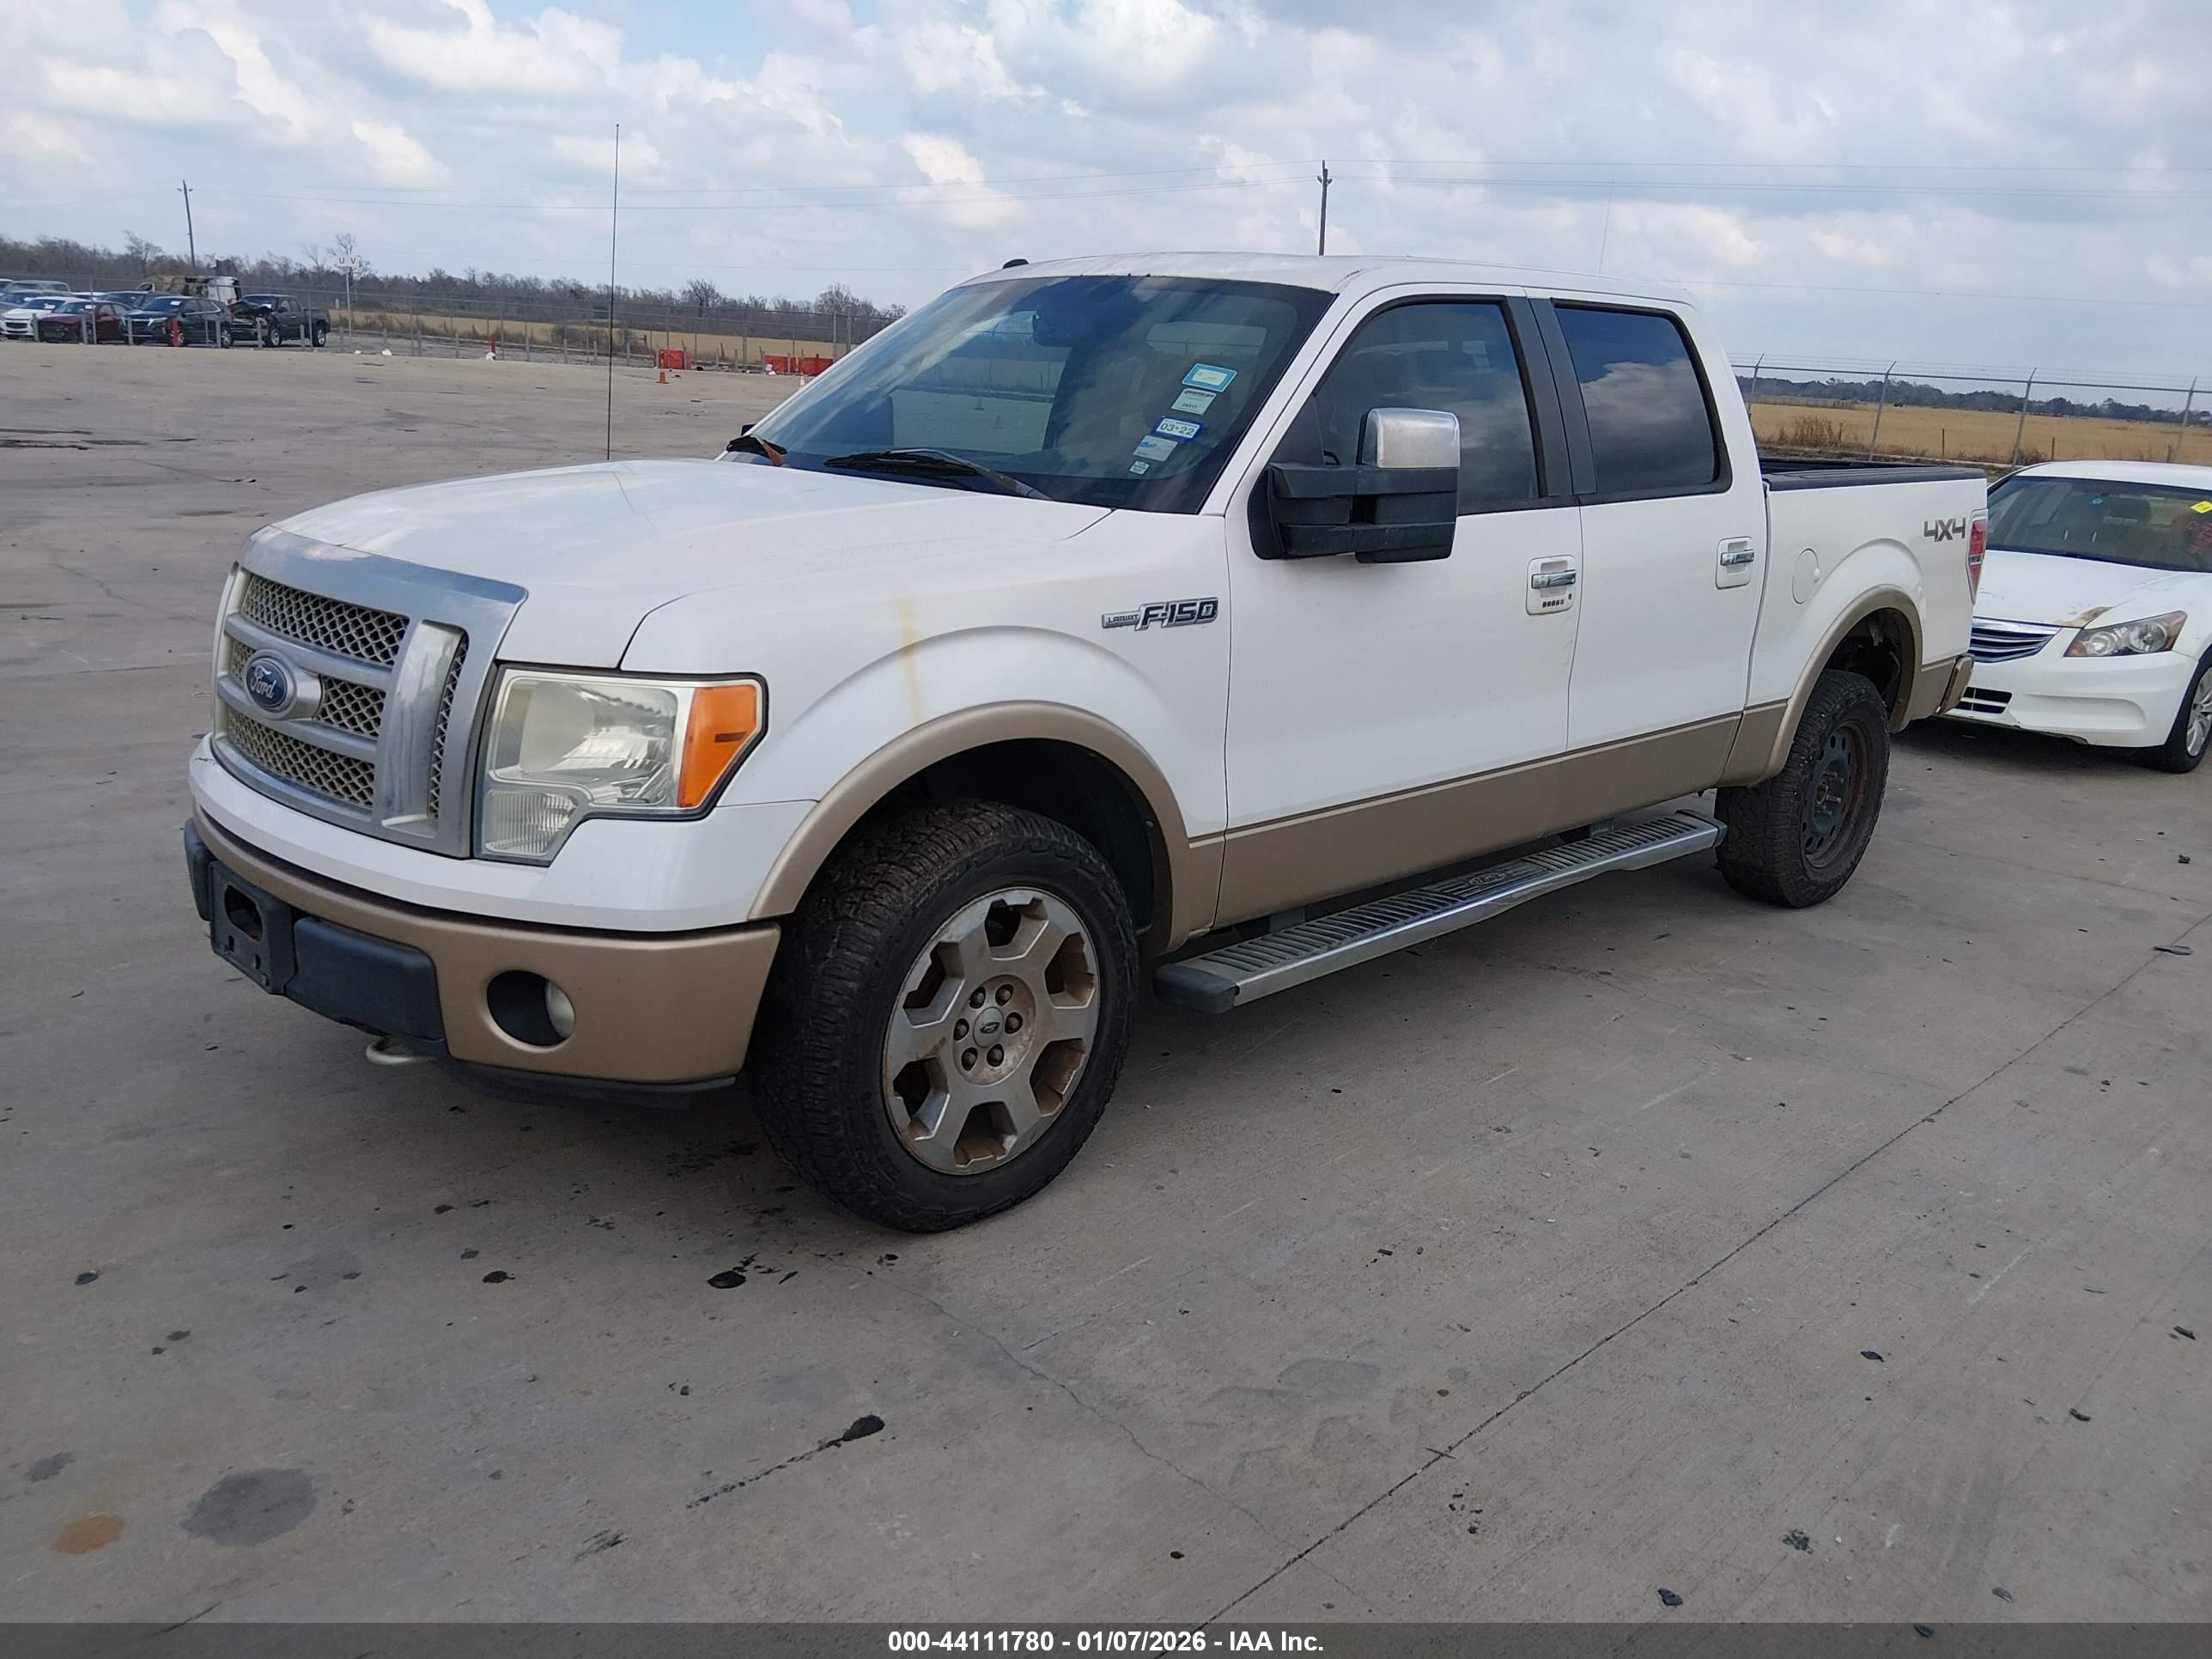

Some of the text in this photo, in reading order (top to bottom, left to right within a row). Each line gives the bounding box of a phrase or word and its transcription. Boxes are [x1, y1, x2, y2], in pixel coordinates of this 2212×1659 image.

[1108, 598, 1219, 629] LARIAT F-150
[250, 665, 277, 699] Ford
